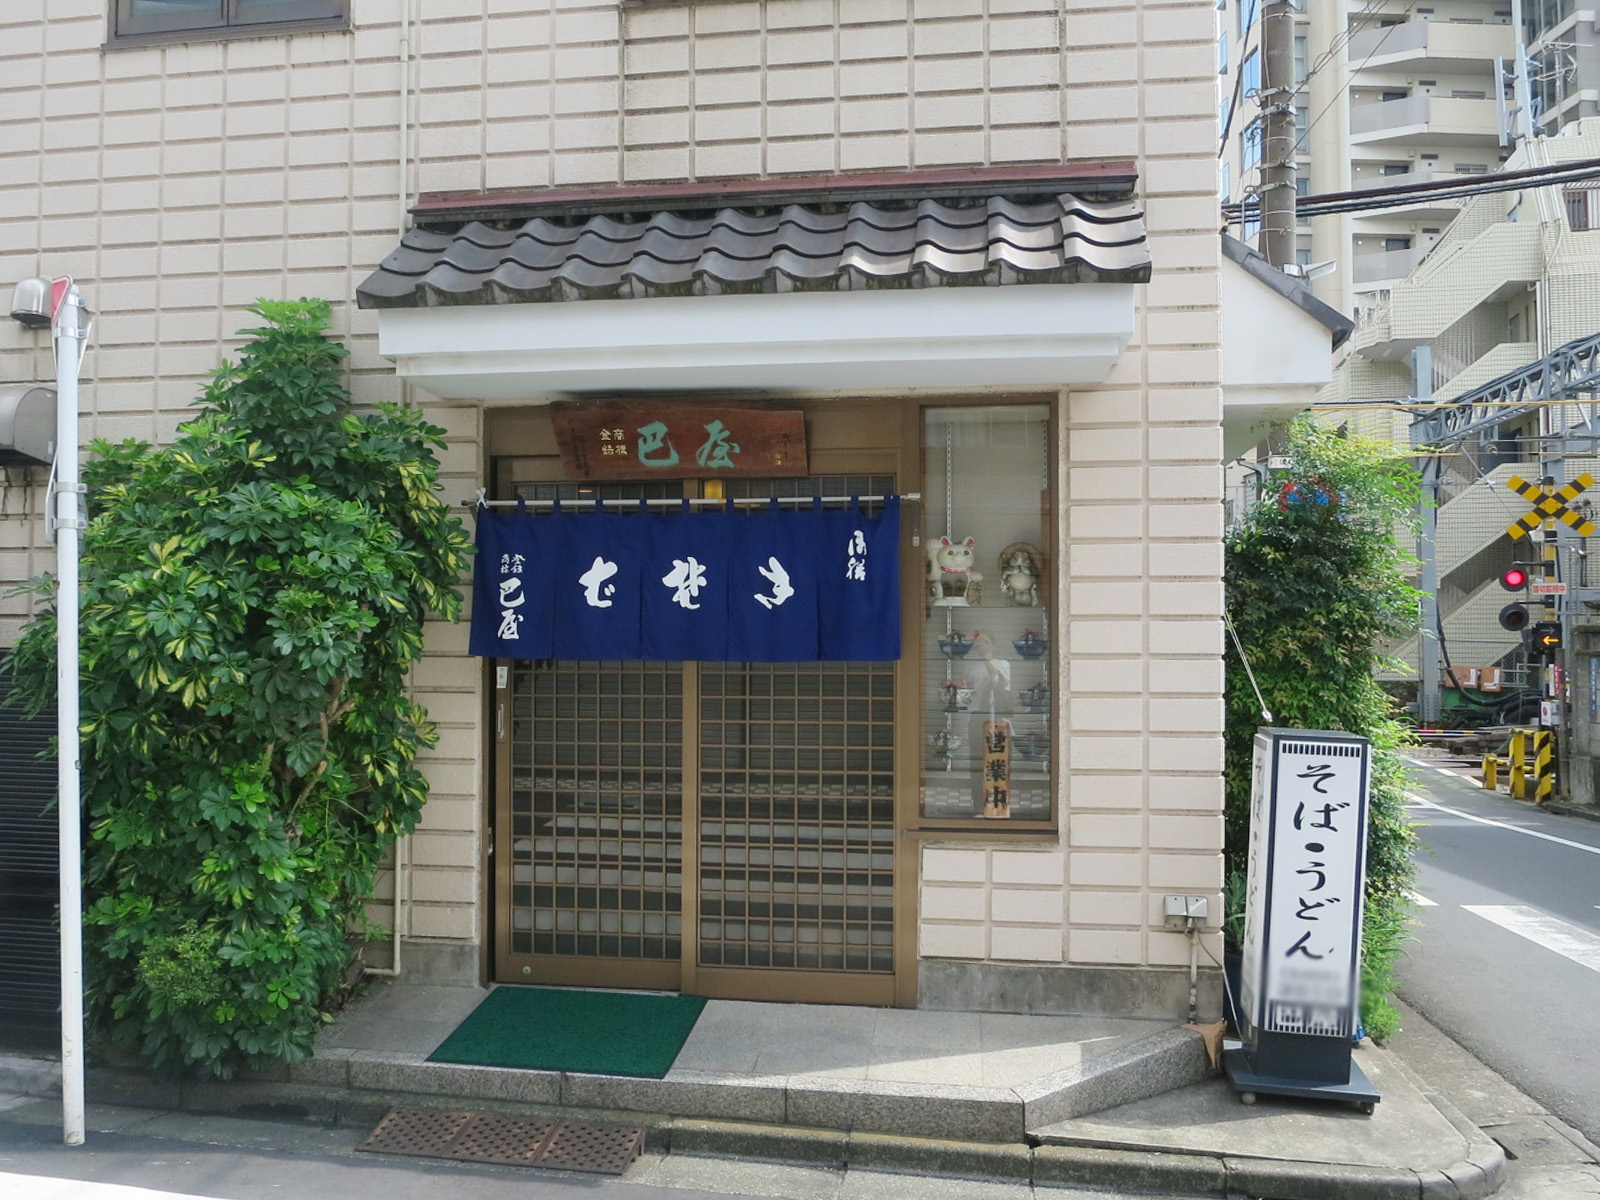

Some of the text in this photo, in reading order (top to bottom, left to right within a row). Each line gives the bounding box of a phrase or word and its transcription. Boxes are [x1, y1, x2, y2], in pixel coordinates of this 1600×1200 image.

[637, 420, 740, 468] 巴屋
[986, 731, 1008, 809] 営業中
[1285, 764, 1350, 959] そば・うどん
